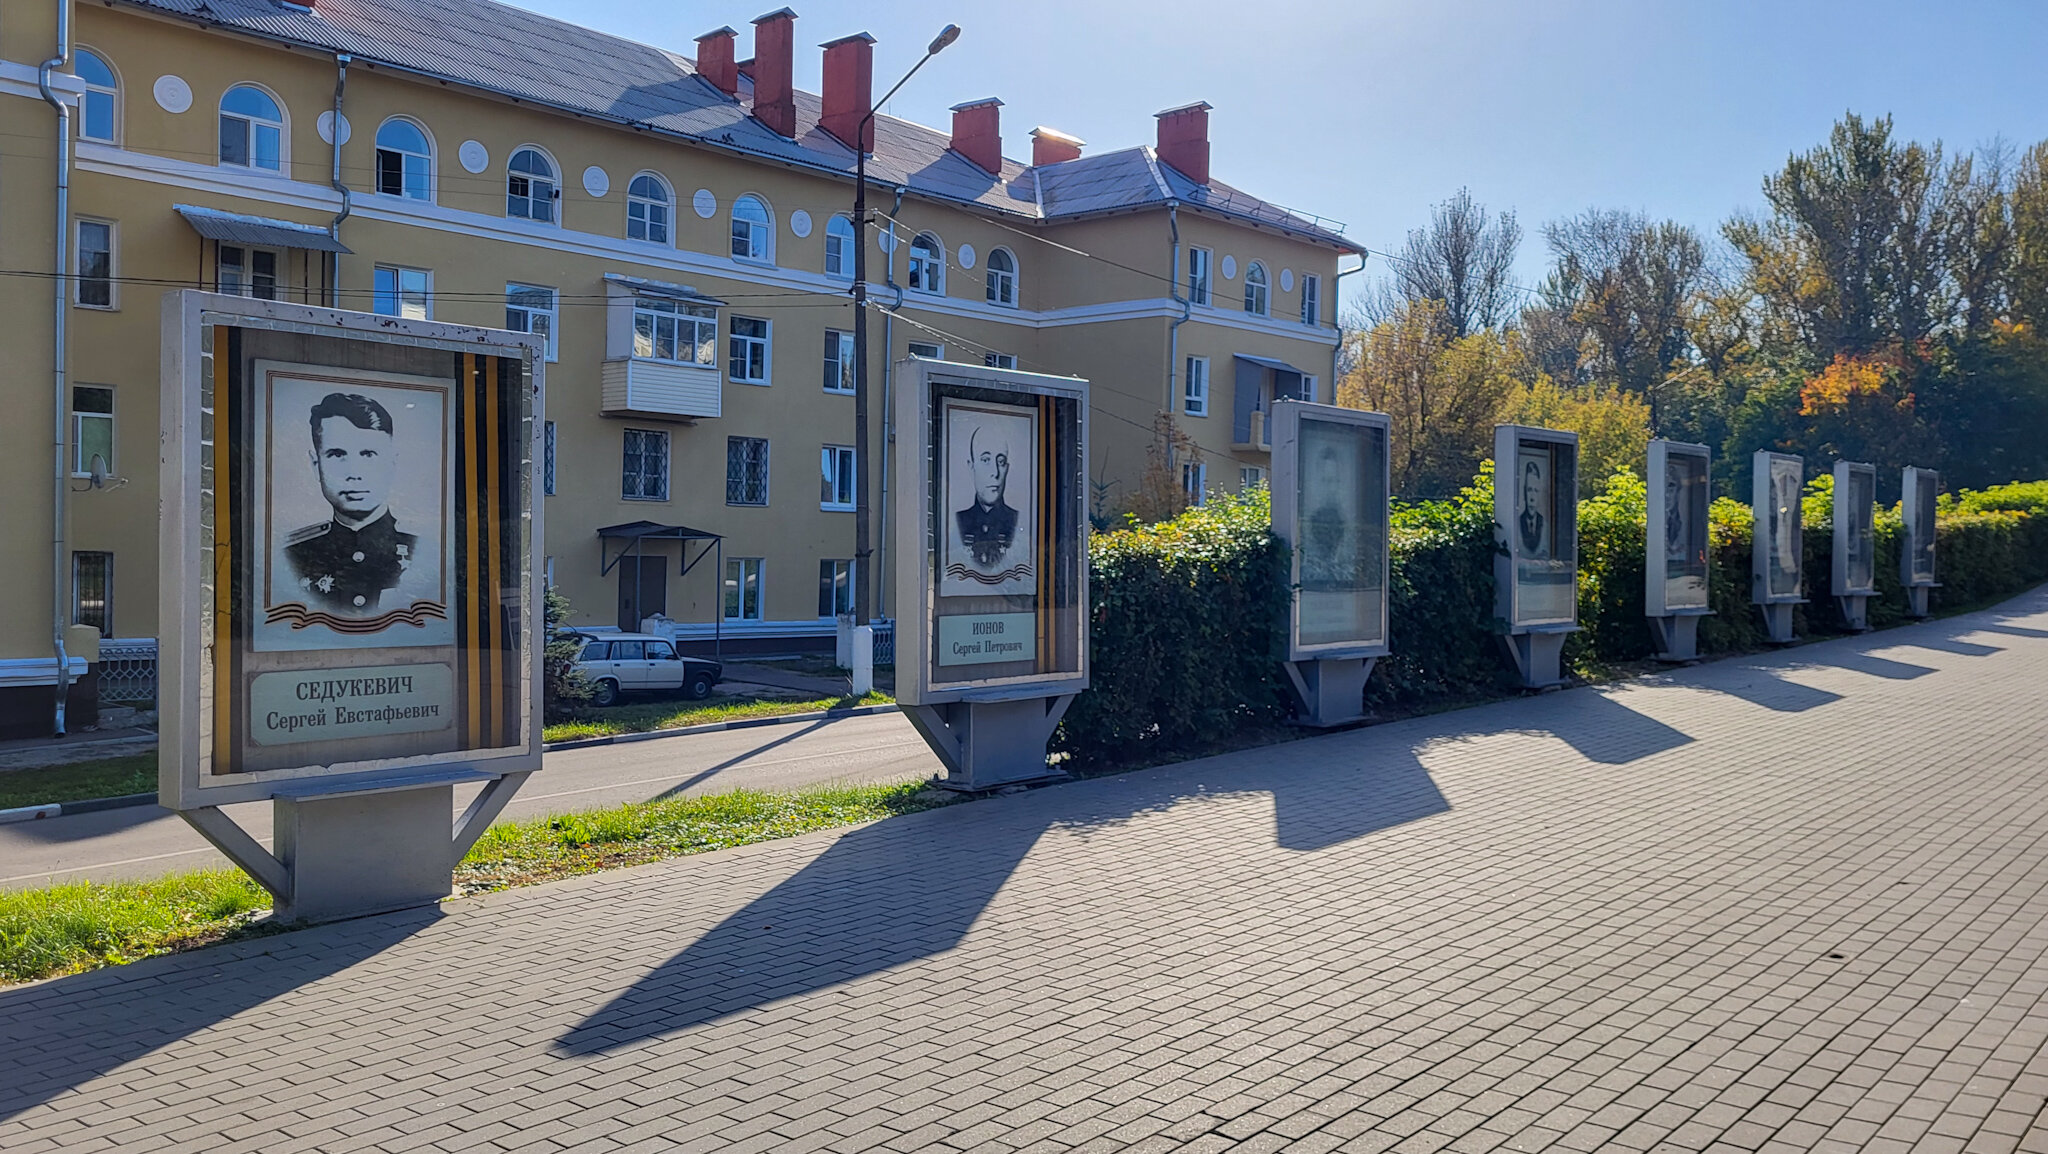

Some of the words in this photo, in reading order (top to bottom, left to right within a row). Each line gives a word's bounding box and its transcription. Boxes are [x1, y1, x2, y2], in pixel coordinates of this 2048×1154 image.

[972, 621, 1005, 636] ИОНОВ
[952, 641, 982, 657] Сергей
[984, 640, 1023, 654] Петрович
[296, 675, 414, 703] СЕДУКЕВИЧ
[266, 708, 327, 733] Сергей
[334, 703, 440, 725] Евстафьевич
